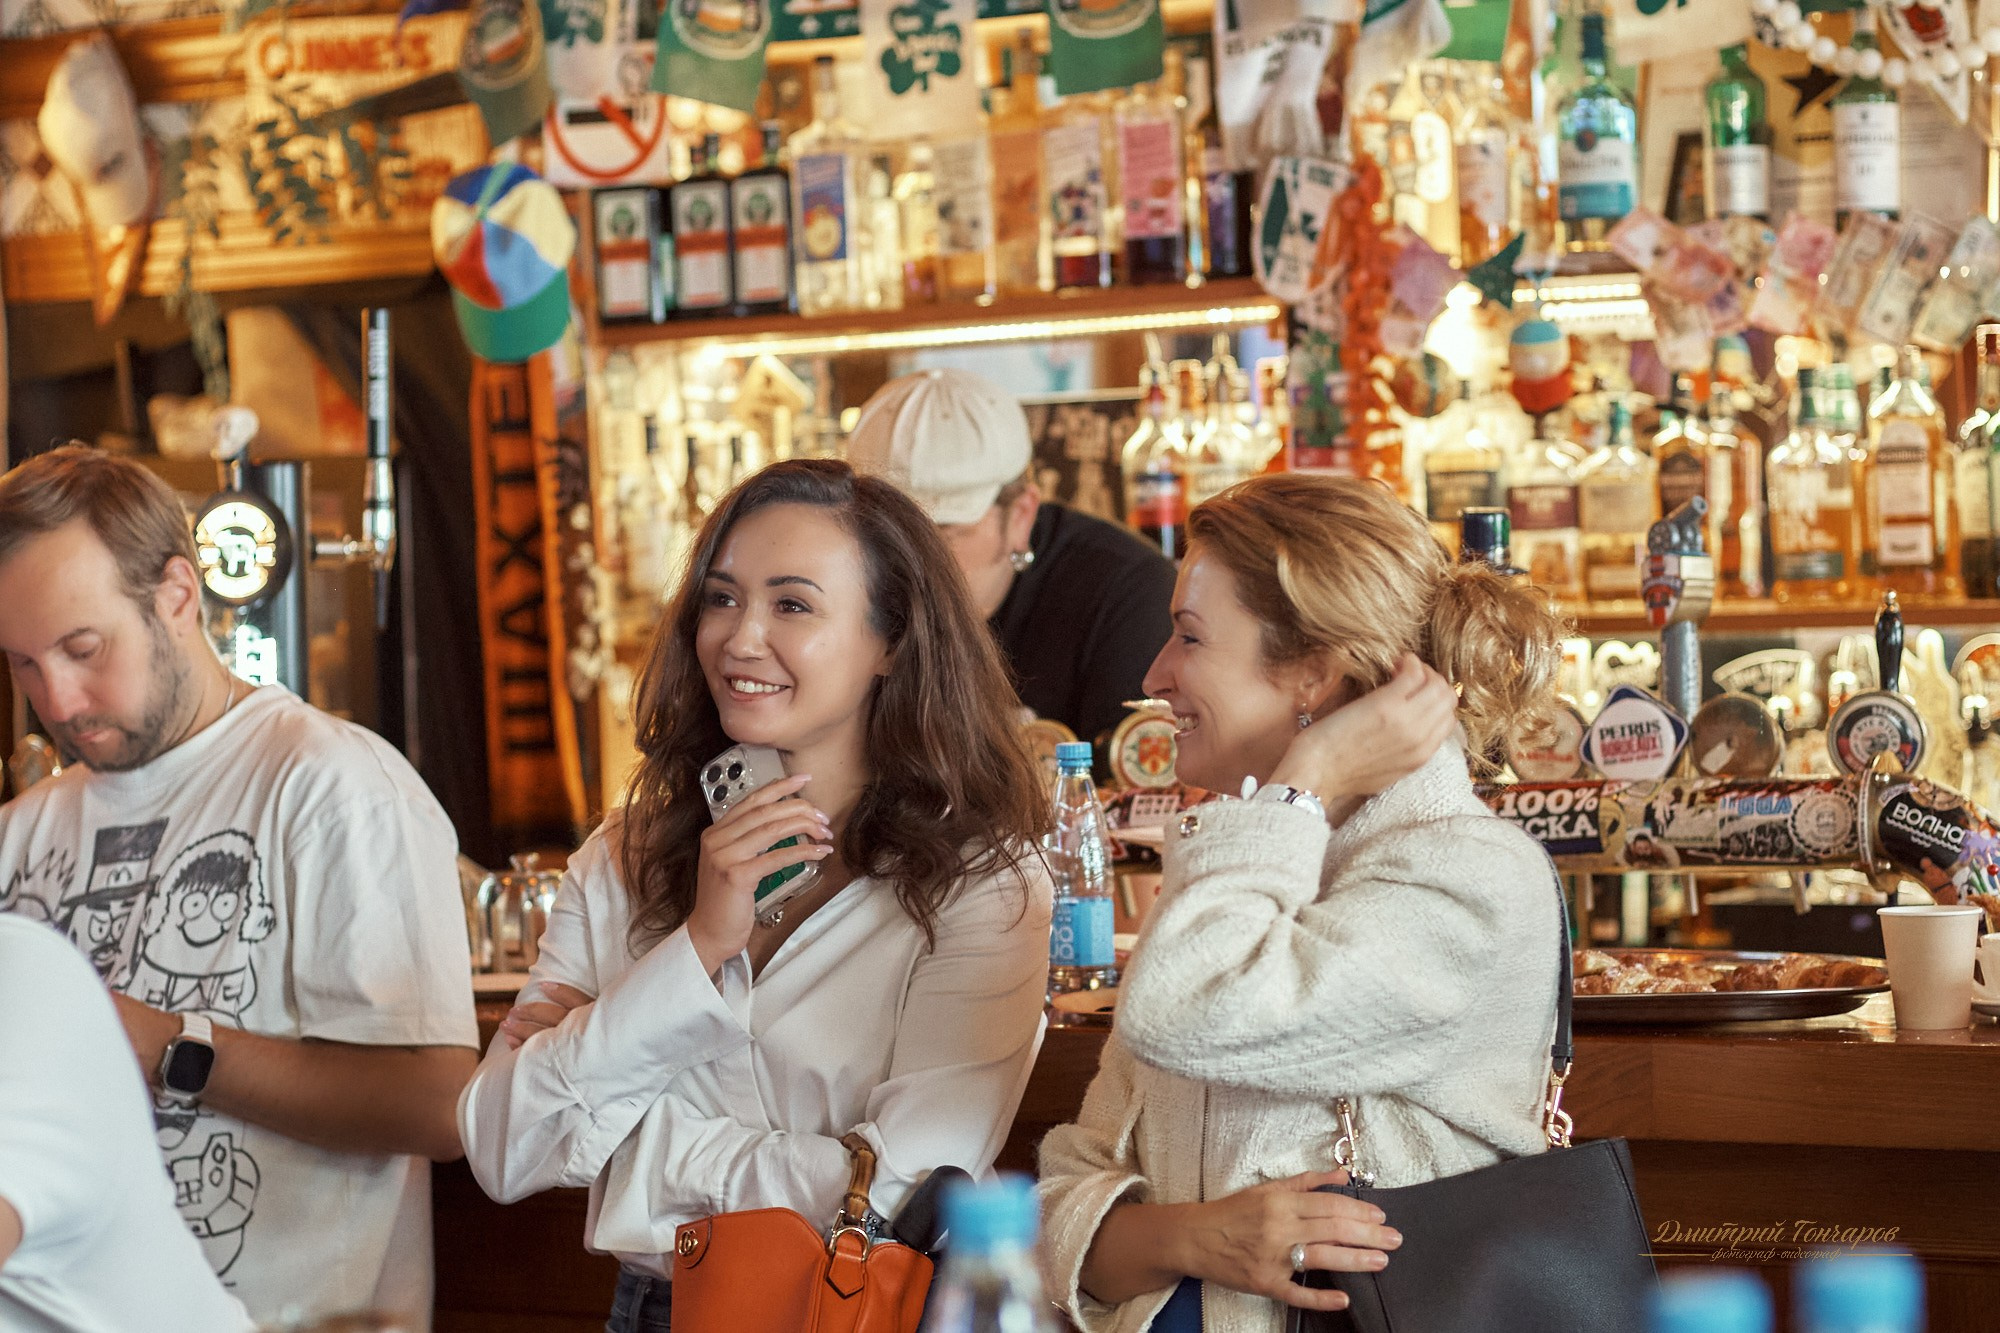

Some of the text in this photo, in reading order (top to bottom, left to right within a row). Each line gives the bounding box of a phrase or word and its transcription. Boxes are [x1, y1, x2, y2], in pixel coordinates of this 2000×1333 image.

[1599, 720, 1661, 741] PETRUS
[1498, 786, 1599, 818] 100%
[1513, 813, 1598, 840] СКА
